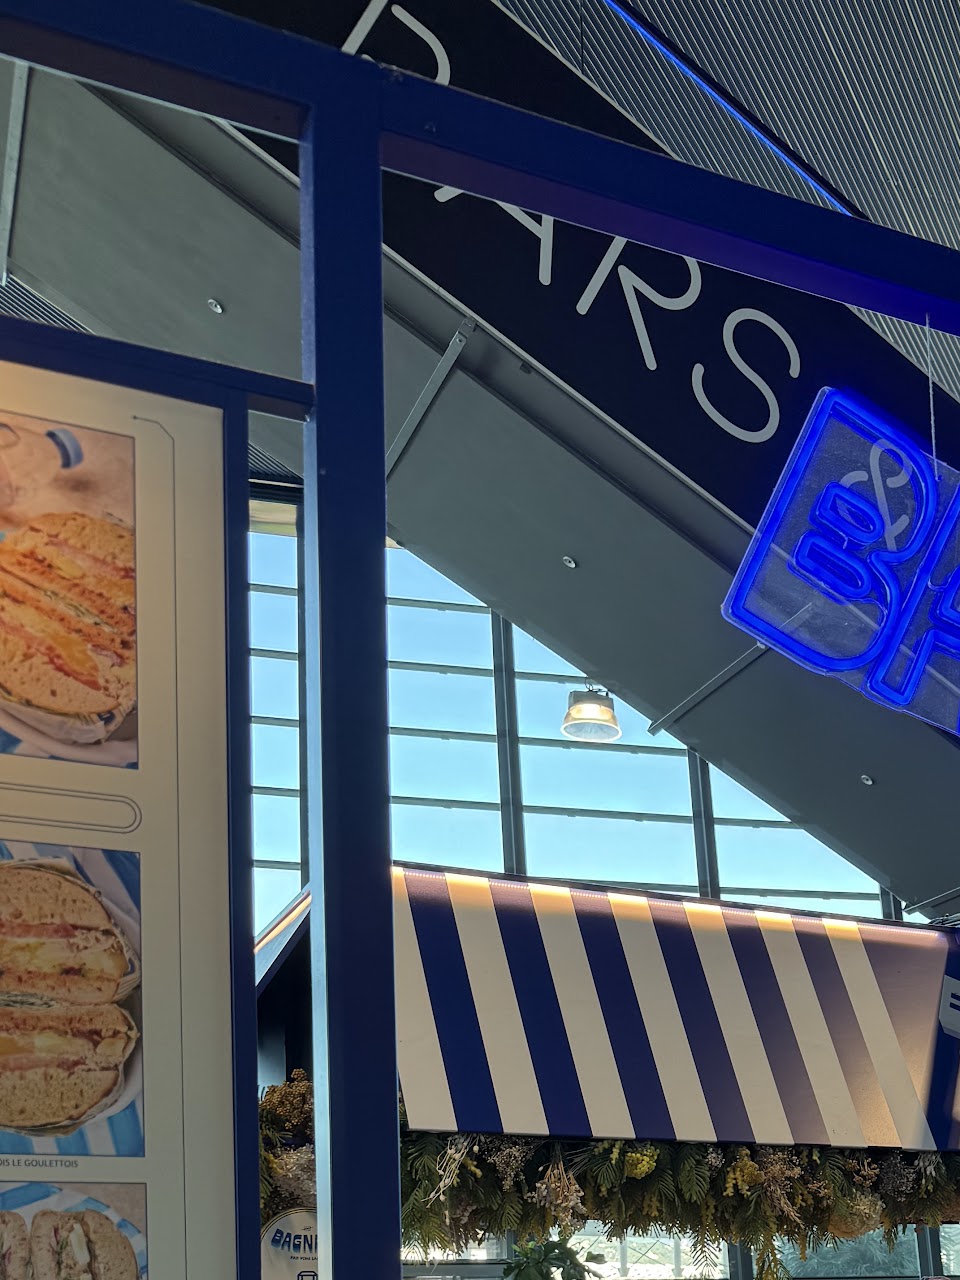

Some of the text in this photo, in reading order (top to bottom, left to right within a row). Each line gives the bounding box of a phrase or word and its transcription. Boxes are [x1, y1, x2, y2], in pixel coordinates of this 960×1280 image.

[12, 1159, 22, 1167] LE
[24, 1159, 79, 1168] GOULETTOIS
[271, 1228, 318, 1254] BAGN
